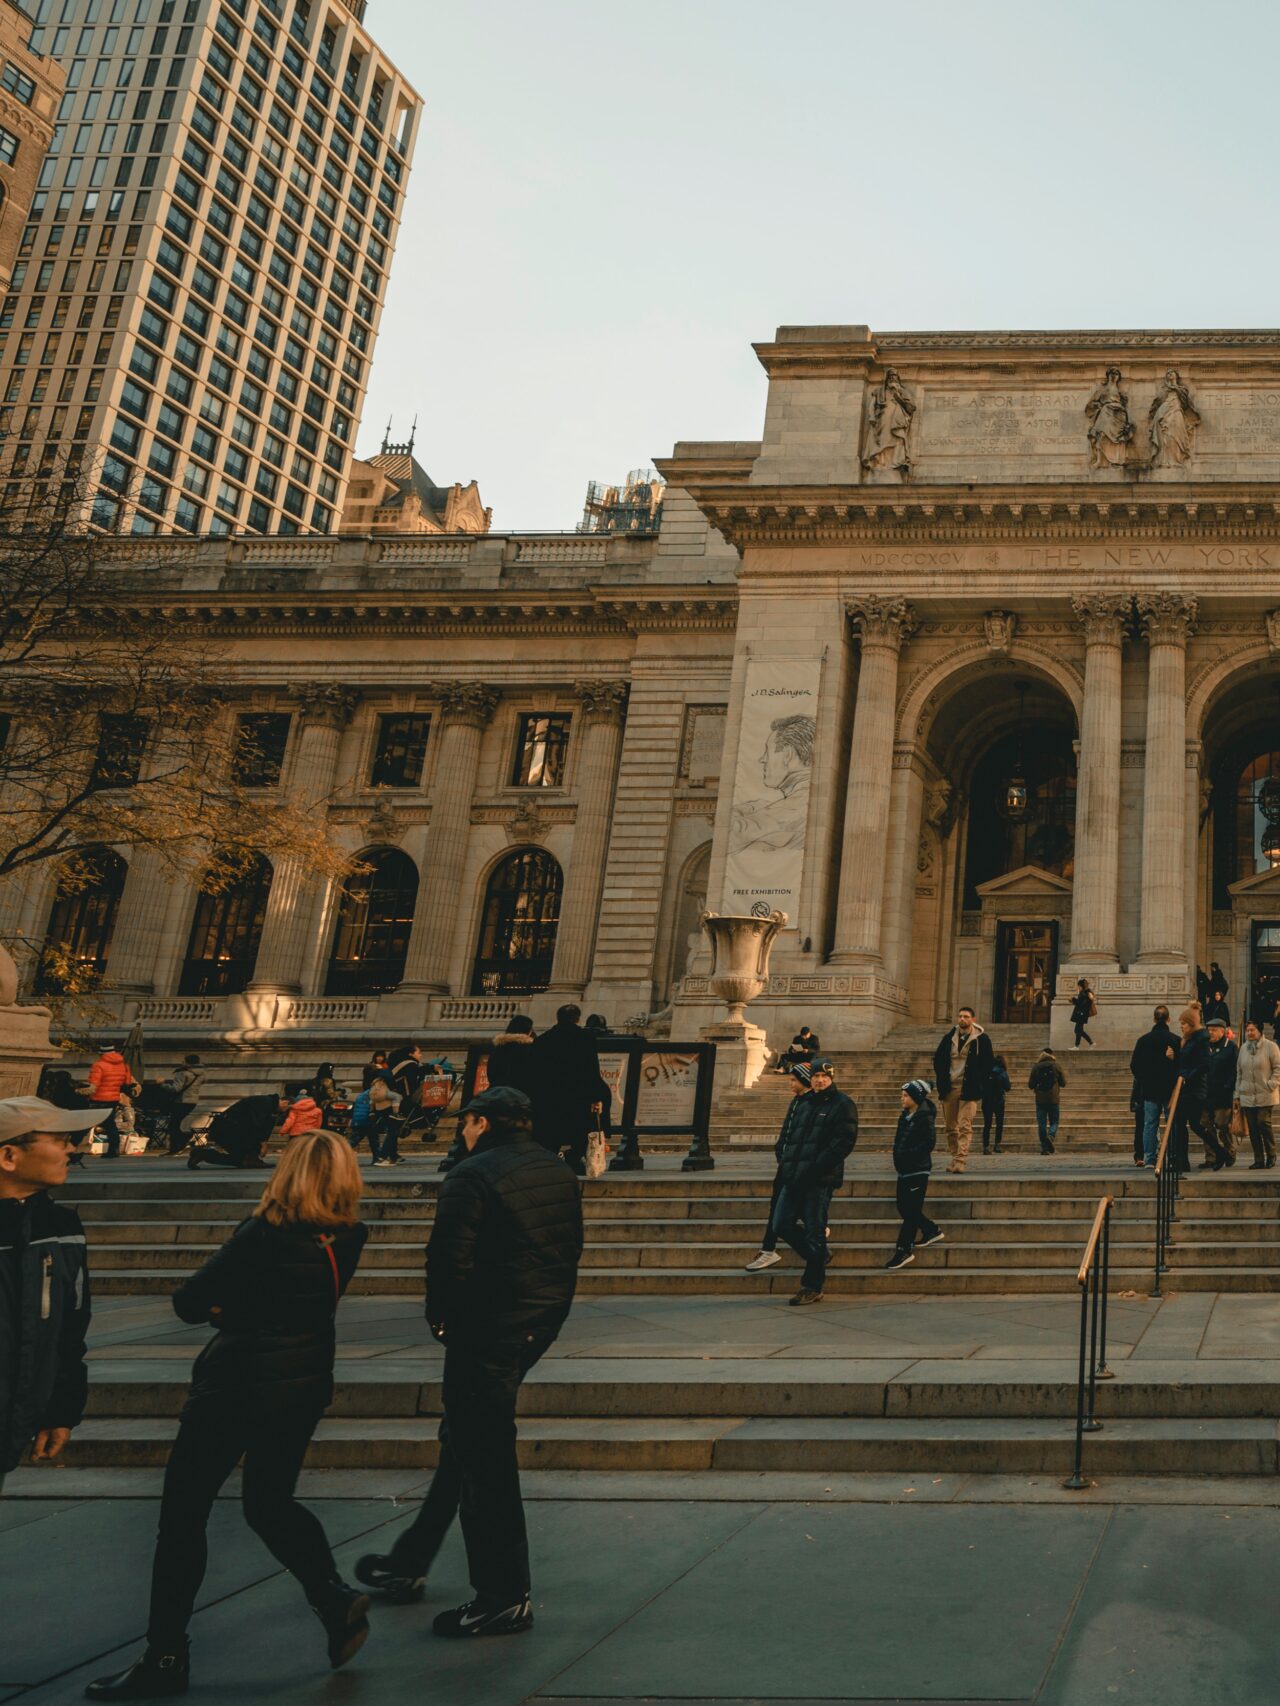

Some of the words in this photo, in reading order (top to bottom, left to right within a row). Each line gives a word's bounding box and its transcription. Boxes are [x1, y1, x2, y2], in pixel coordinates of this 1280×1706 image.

[933, 395, 960, 408] THE
[968, 395, 1014, 408] ASTOR
[1021, 394, 1080, 408] LIBRARY
[1205, 393, 1232, 406] THE
[1026, 419, 1059, 428] ASTOR
[1238, 418, 1275, 426] JAMES
[860, 551, 963, 566] MDCCCXCV
[1024, 548, 1083, 567] THE
[1104, 548, 1174, 567] NEW
[1199, 547, 1272, 567] YORK
[750, 888, 792, 896] EXHIBITION
